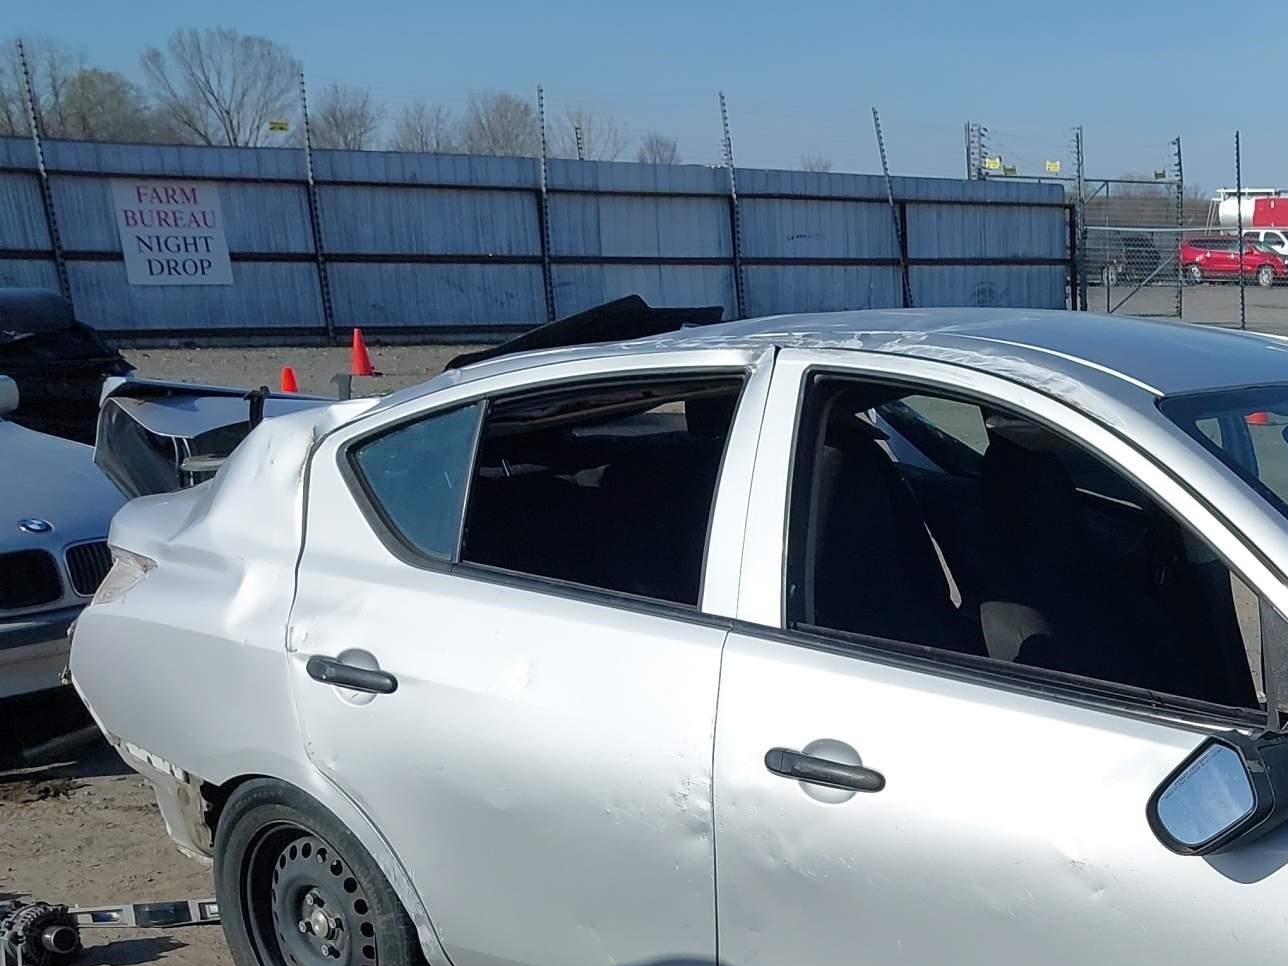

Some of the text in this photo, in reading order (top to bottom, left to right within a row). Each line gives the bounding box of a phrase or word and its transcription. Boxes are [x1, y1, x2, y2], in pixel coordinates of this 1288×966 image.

[135, 185, 198, 204] FARM
[122, 208, 217, 229] BUREAU
[135, 235, 215, 254] NIGHT
[146, 258, 212, 276] DROP
